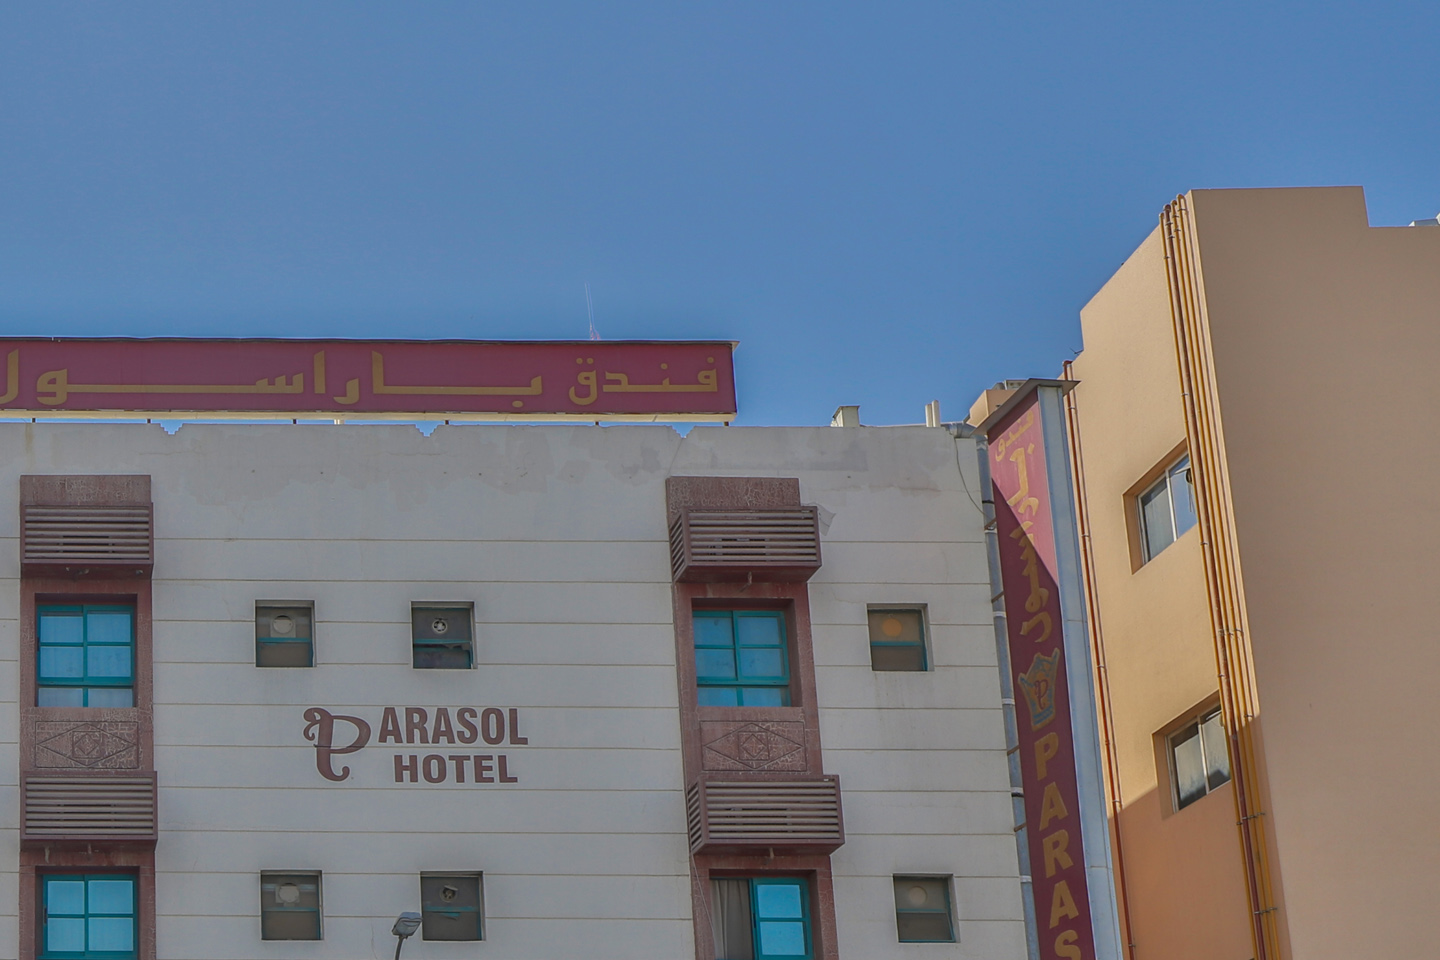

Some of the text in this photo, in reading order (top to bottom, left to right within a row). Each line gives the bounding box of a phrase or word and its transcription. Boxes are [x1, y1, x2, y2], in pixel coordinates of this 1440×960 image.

[568, 355, 720, 406] فندق
[302, 706, 529, 782] PARASOL
[393, 753, 519, 784] HOTEL
